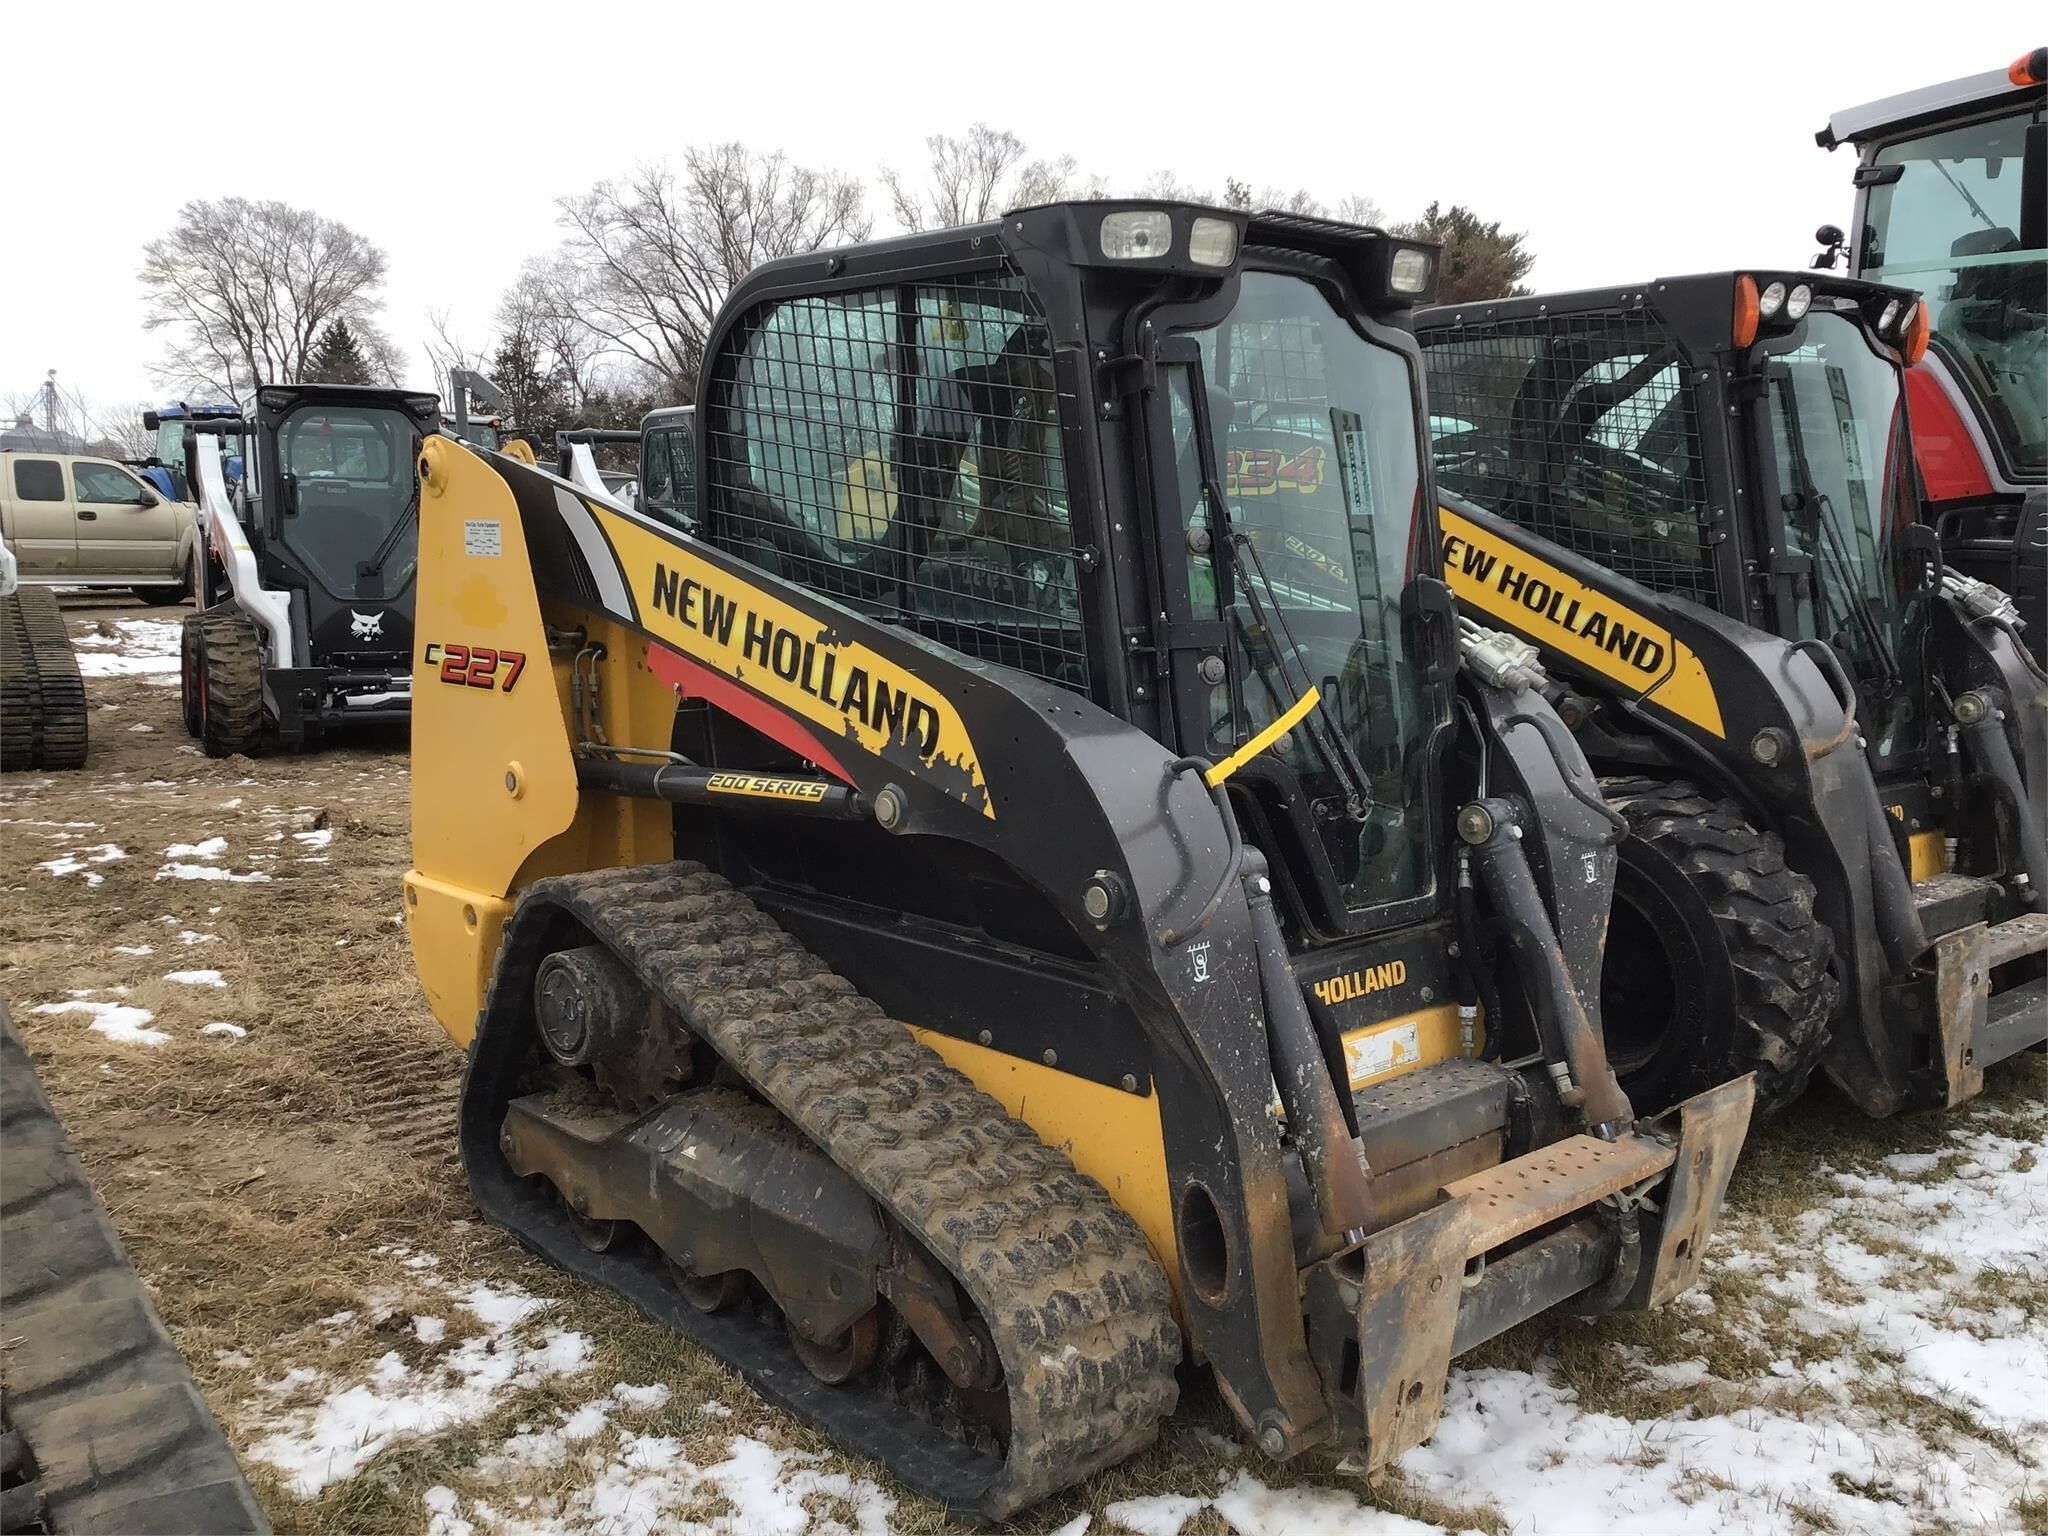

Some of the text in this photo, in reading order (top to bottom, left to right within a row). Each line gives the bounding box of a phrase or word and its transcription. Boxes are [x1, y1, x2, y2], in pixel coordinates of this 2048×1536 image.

[1442, 530, 1497, 583] EW
[1497, 563, 1664, 674] HOLLAND
[424, 643, 526, 692] C227
[652, 562, 940, 758] NEW HOLLAND
[708, 775, 827, 797] 200 SERIES
